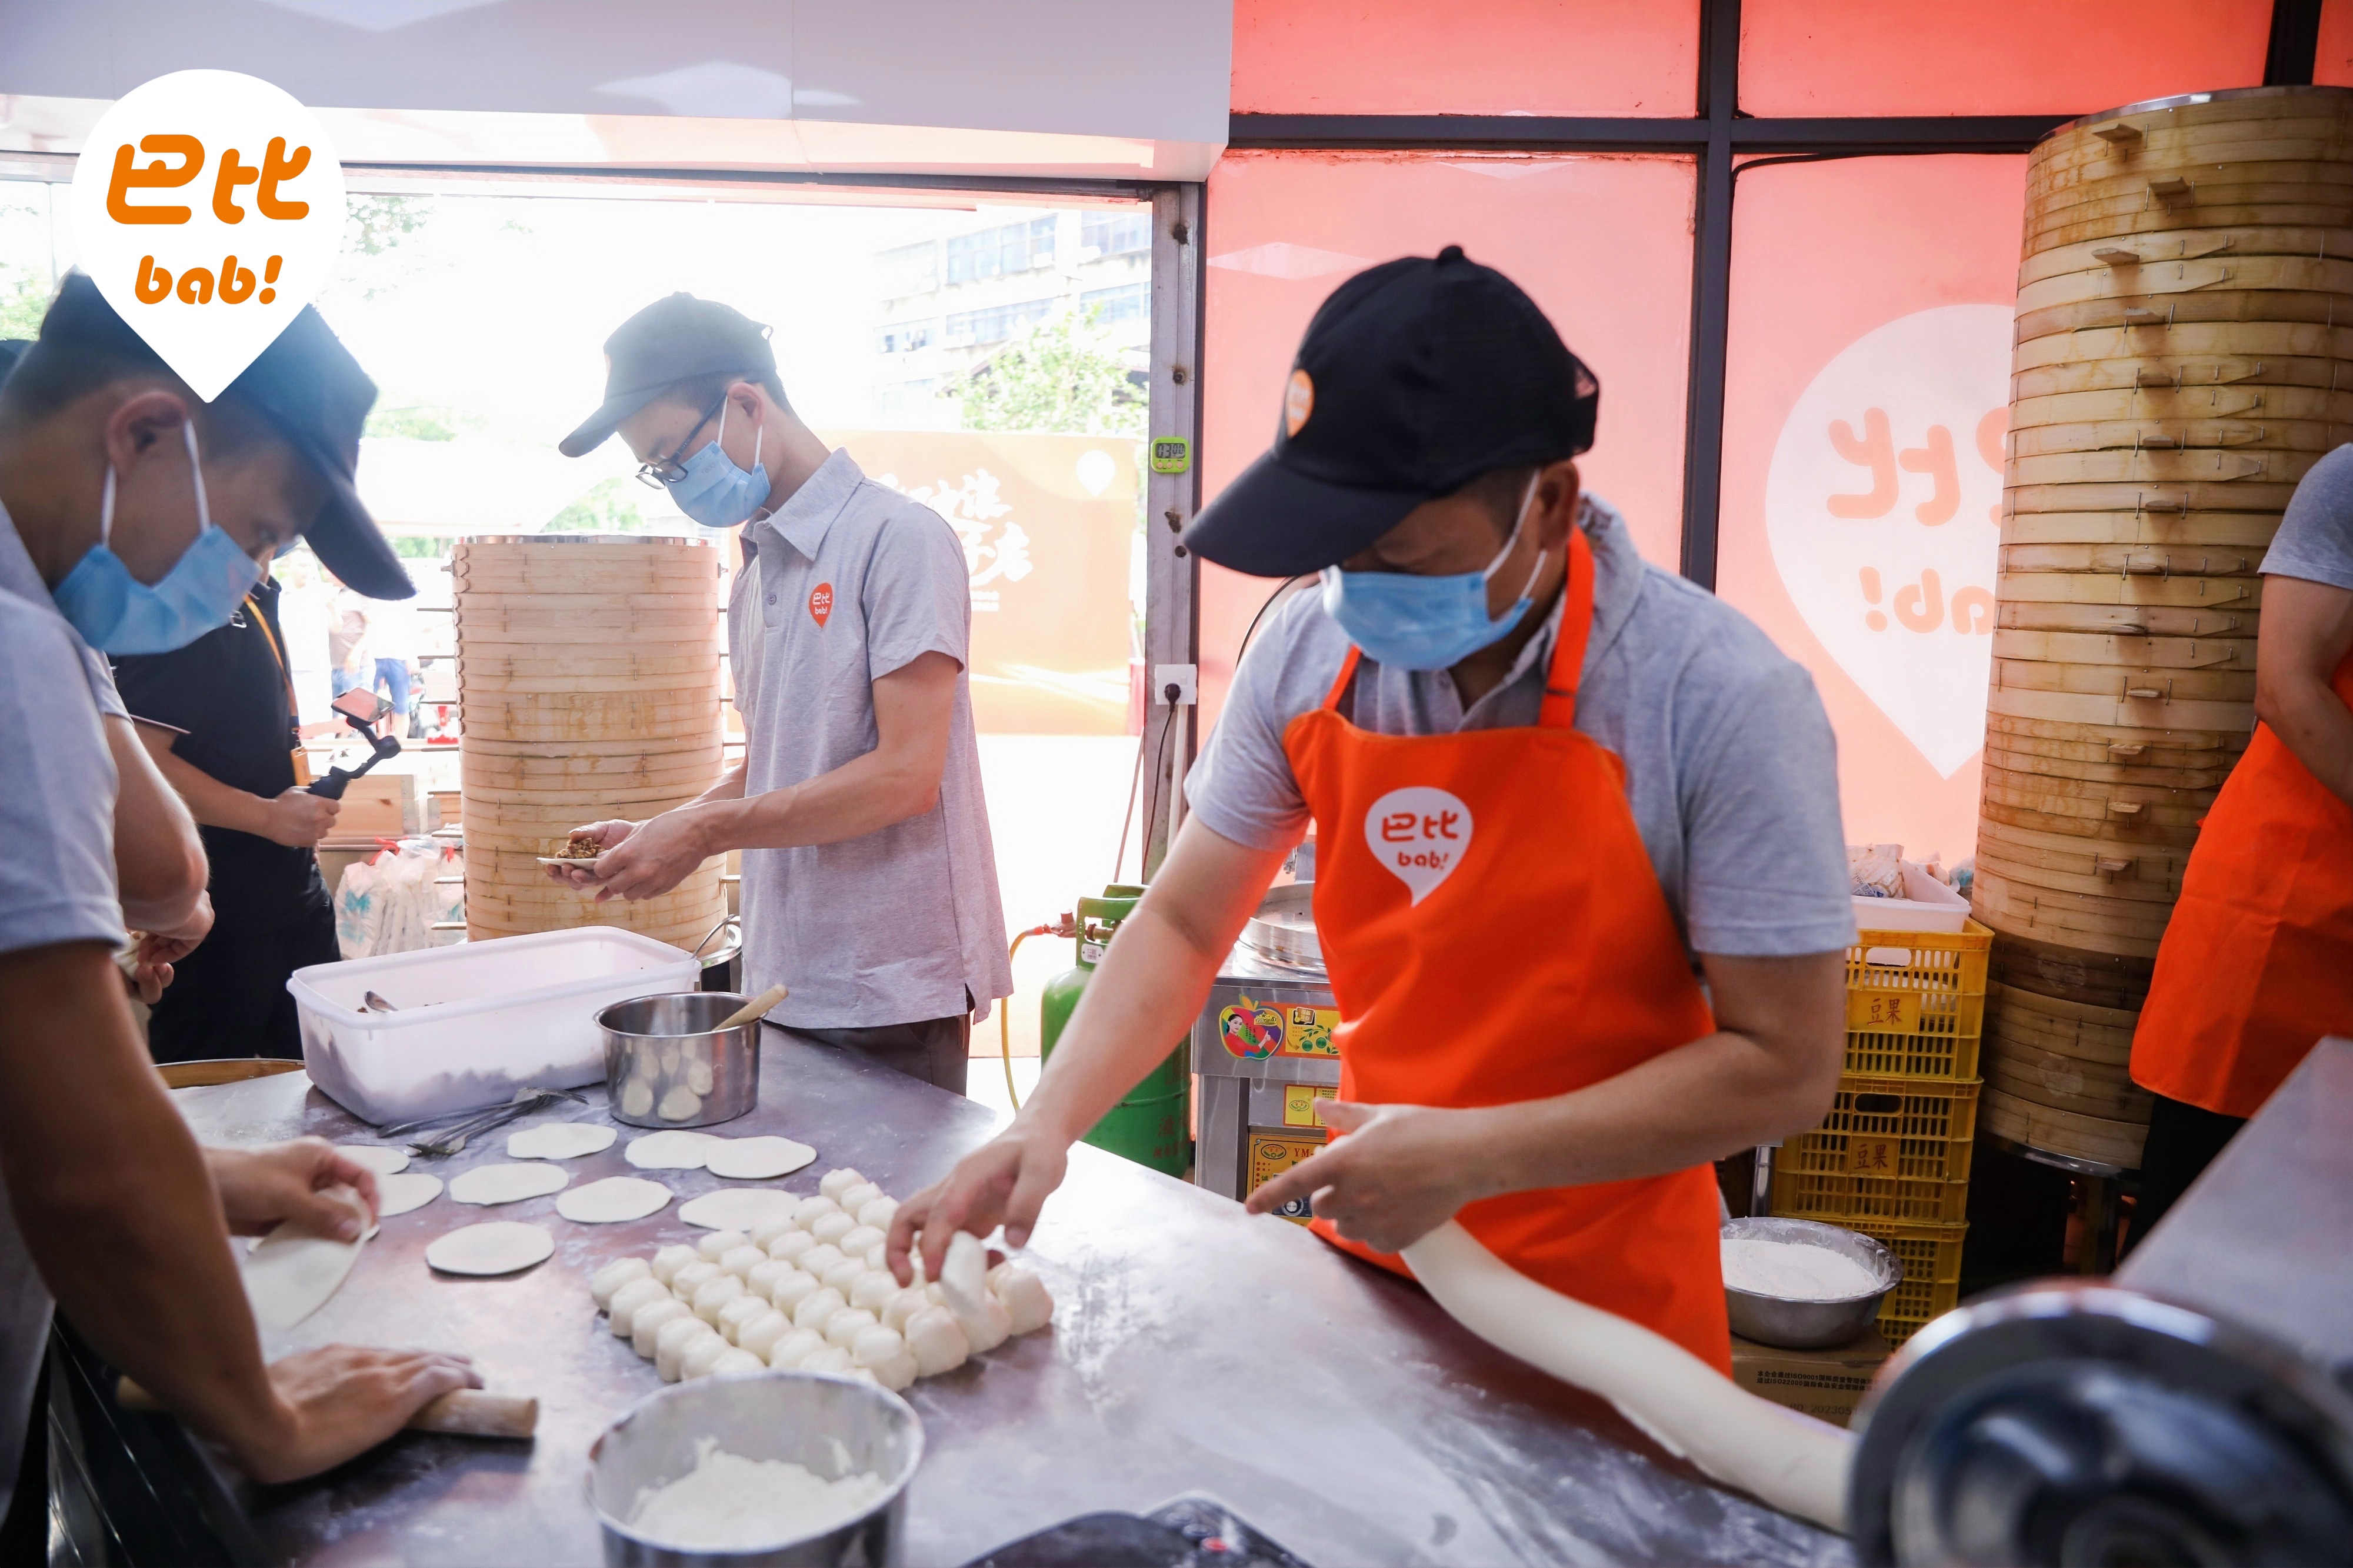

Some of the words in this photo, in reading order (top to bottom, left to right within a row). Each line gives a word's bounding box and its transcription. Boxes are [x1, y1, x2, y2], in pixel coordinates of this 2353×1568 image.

[812, 592, 830, 605] 巴比
[1381, 810, 1459, 842] 巴比
[1398, 850, 1449, 870] bab!
[1867, 998, 1902, 1025] 豆果
[1854, 1143, 1888, 1170] 豆果
